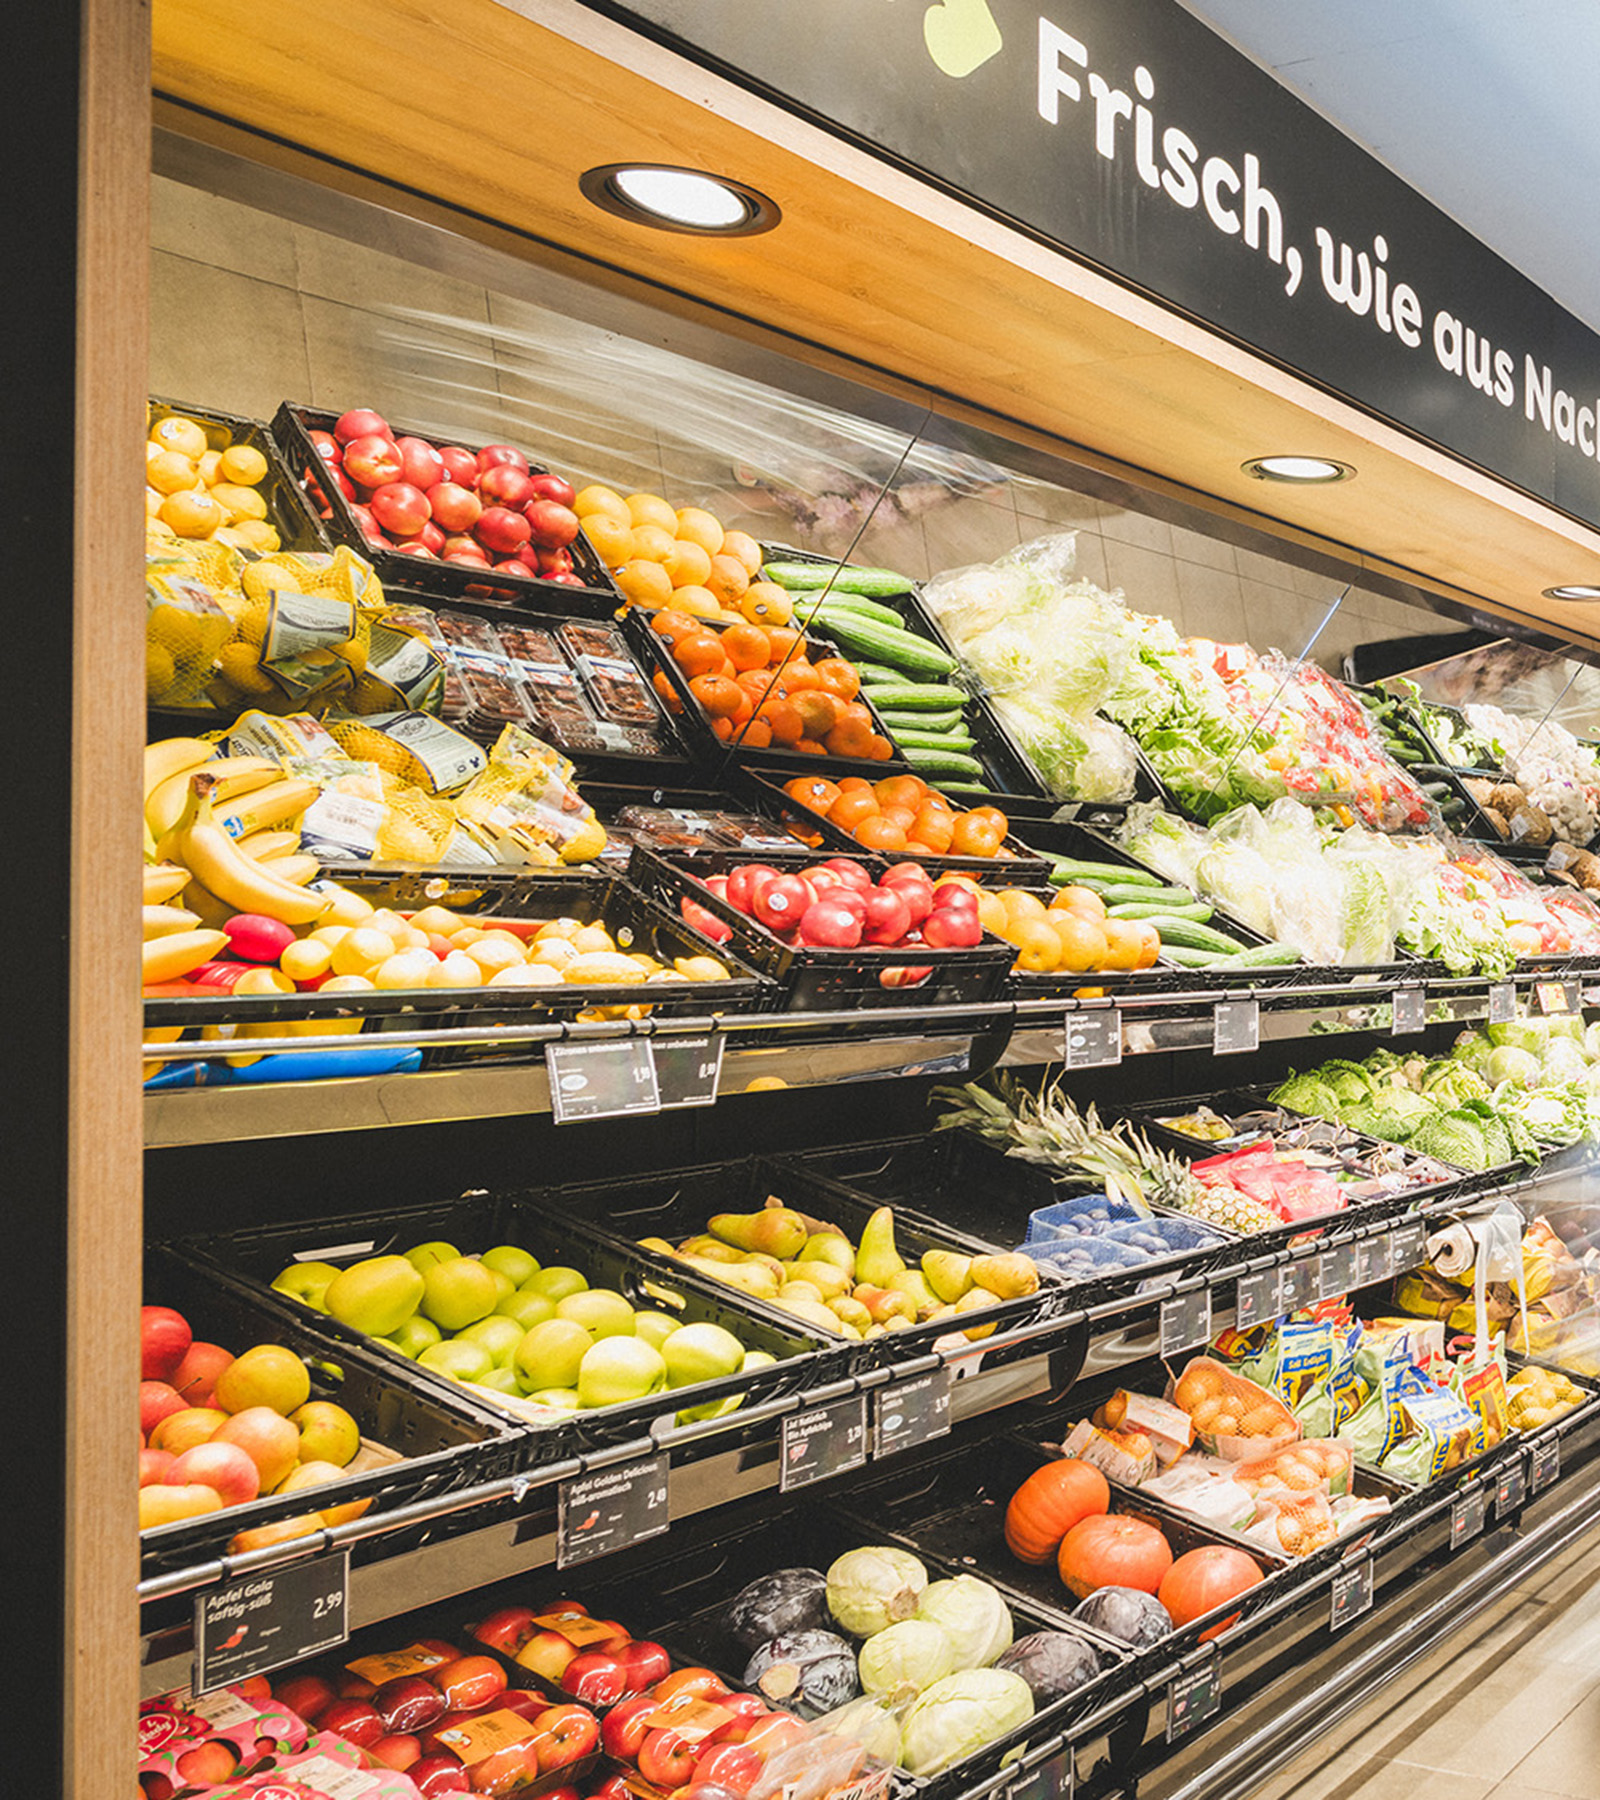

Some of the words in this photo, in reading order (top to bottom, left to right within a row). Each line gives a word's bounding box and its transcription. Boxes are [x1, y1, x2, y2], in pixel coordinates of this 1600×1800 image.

[1037, 15, 1303, 297] Frisch,
[1315, 227, 1422, 348] wie
[1433, 310, 1515, 407] aus
[206, 1586, 243, 1611] Apfel
[244, 1579, 274, 1598] Gala
[206, 1592, 274, 1625] saftig-süß
[313, 1590, 343, 1620] 2.99
